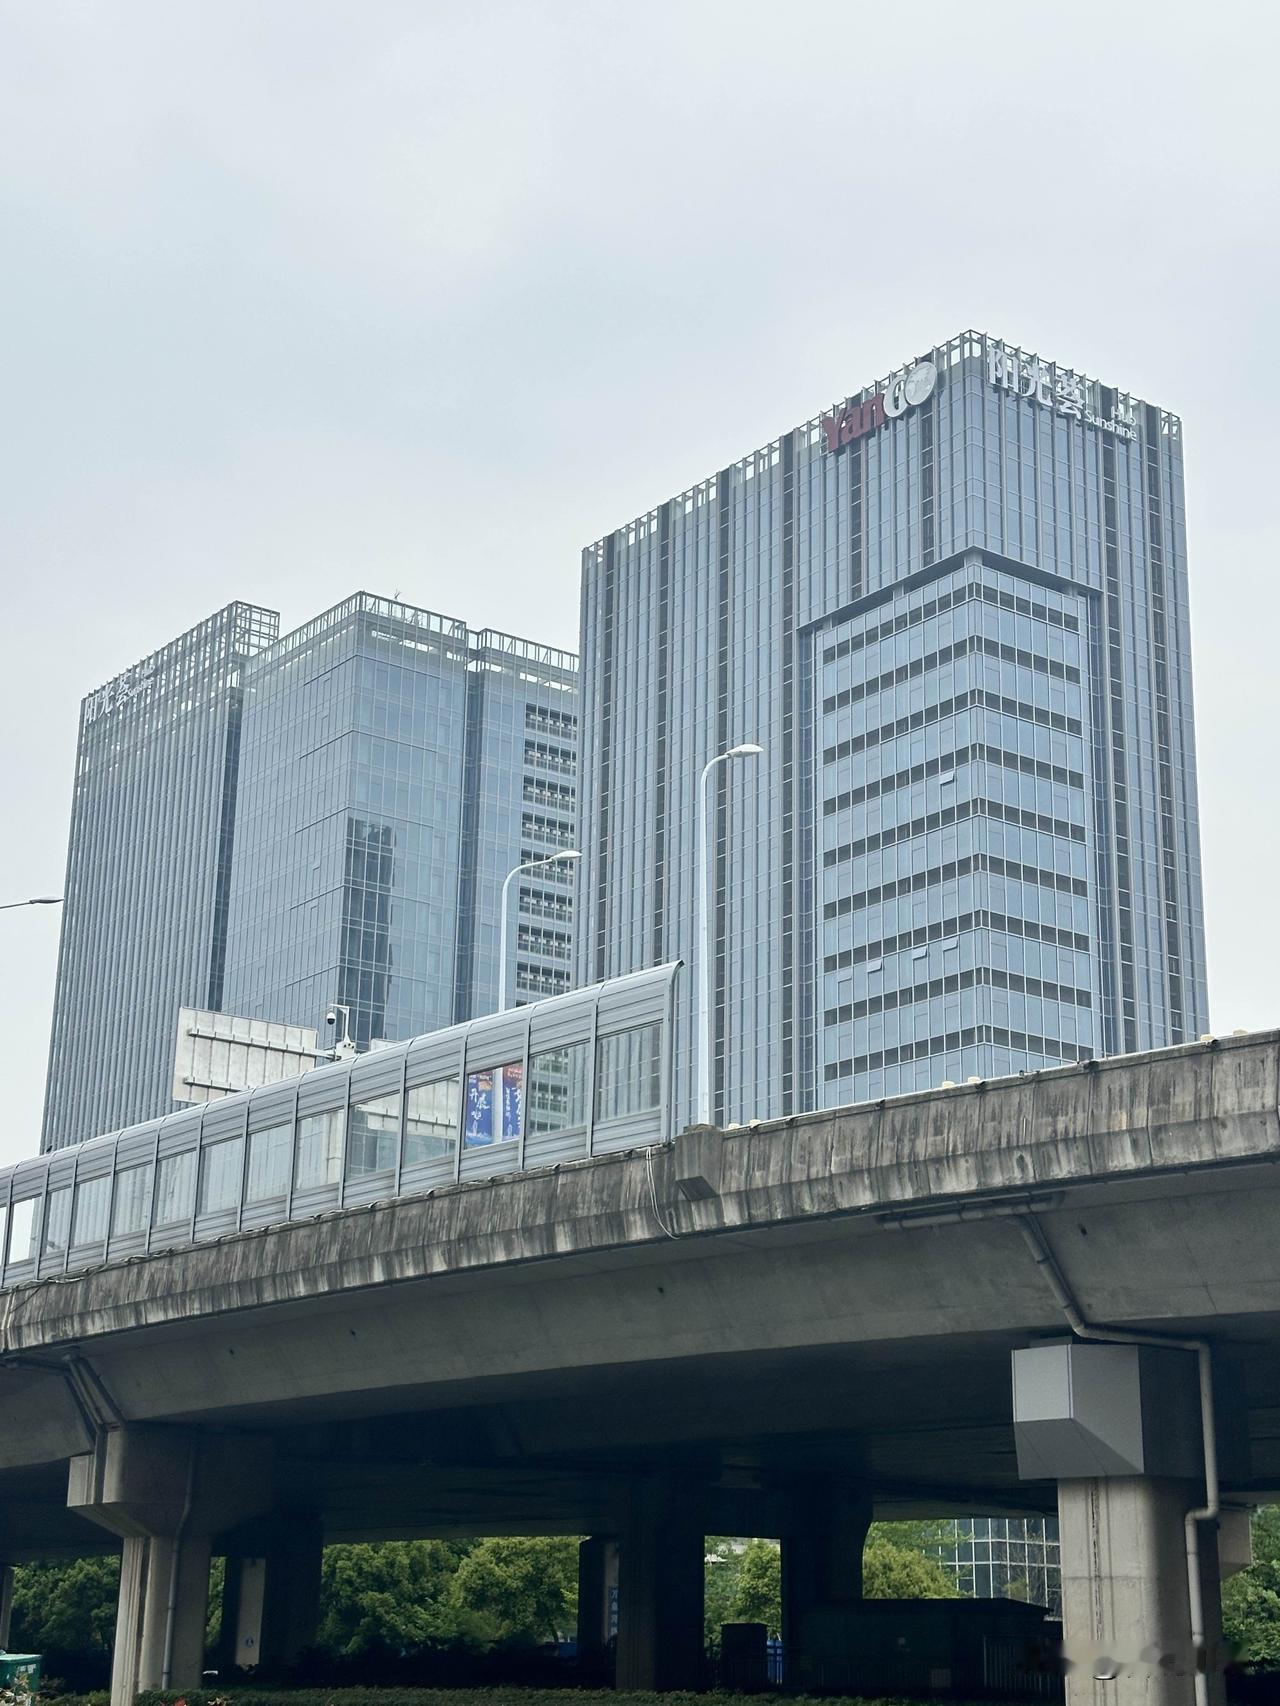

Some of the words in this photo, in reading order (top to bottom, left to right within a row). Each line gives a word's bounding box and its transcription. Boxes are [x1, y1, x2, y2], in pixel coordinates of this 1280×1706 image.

[986, 344, 1086, 420] 阳光荟
[1084, 409, 1138, 441] Sunshine
[1110, 405, 1137, 427] Hub
